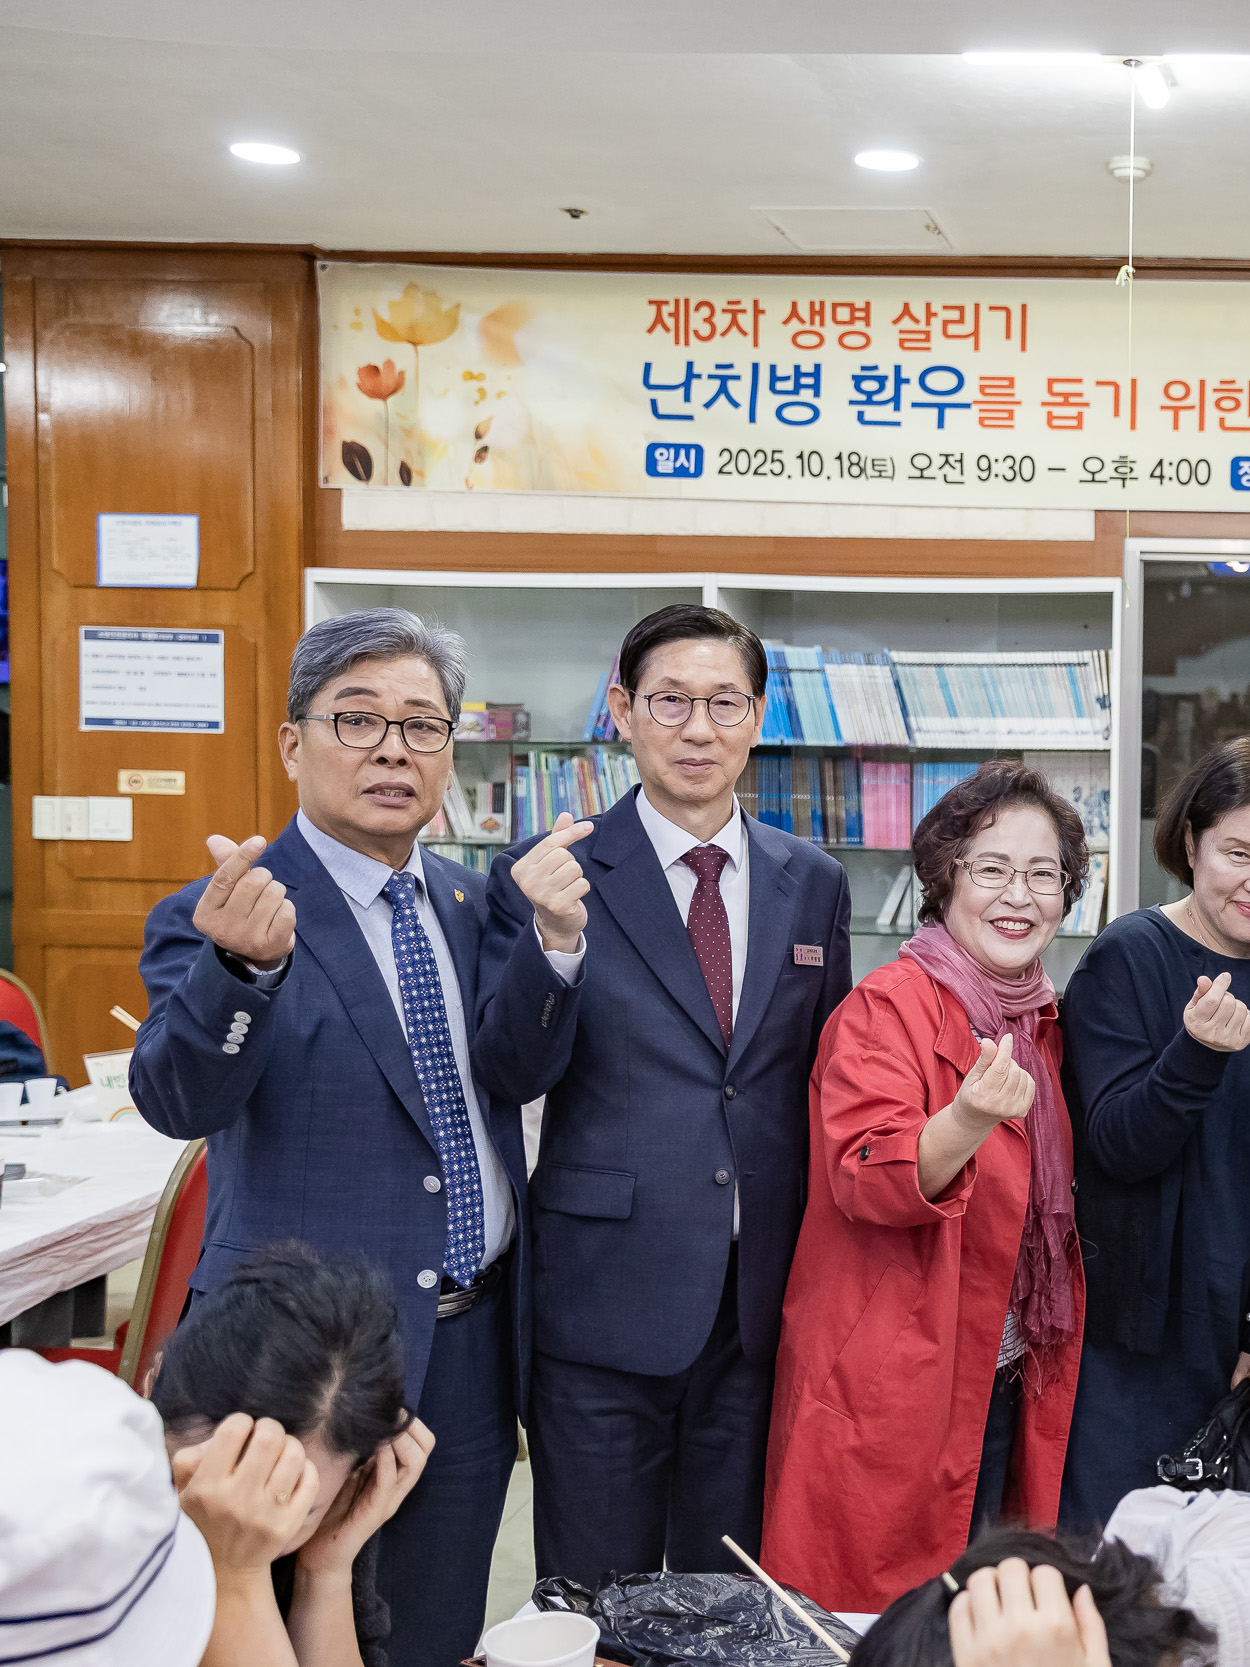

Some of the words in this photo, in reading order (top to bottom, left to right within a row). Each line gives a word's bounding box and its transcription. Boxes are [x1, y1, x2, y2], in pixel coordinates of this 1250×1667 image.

[645, 297, 767, 349] 제3차
[780, 298, 873, 352] 생명
[890, 301, 1029, 353] 살리기
[642, 360, 822, 427] 난치병
[848, 363, 1023, 430] 환우를
[1040, 377, 1138, 432] 돕기
[654, 448, 697, 474] 일시
[717, 447, 896, 481] 2025.10.18(토)
[907, 452, 966, 485] 오전
[976, 454, 1036, 484] 9:30
[1078, 455, 1139, 489] 오후
[1149, 458, 1212, 487] 4:00
